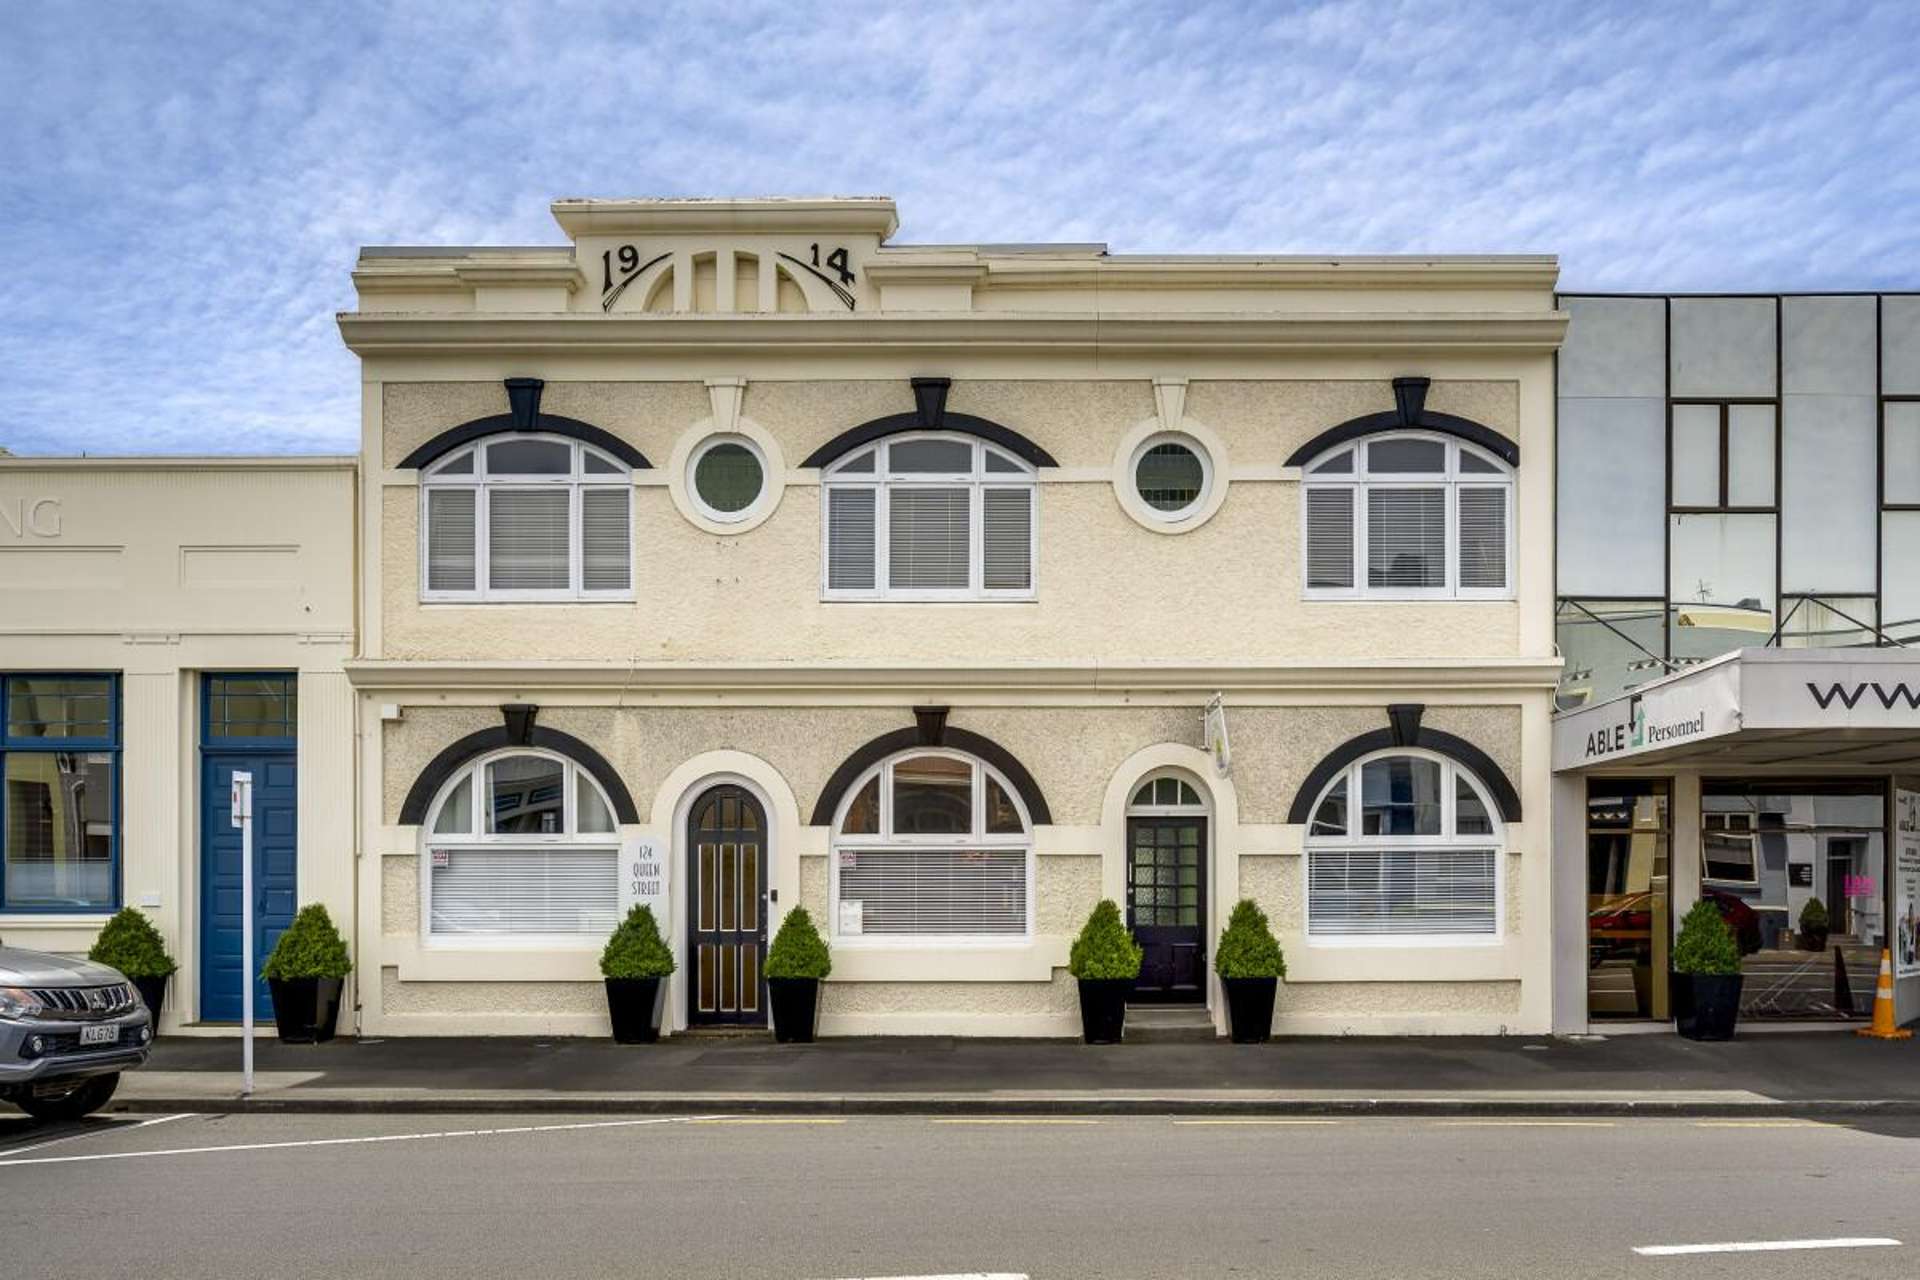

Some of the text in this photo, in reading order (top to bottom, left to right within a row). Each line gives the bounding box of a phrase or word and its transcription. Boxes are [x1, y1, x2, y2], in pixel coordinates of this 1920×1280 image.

[601, 244, 639, 296] 19
[810, 243, 856, 287] 14
[1585, 712, 1705, 758] ABLE Personnel
[639, 845, 653, 860] 124
[633, 862, 661, 877] QUEEN
[632, 880, 661, 895] STREET
